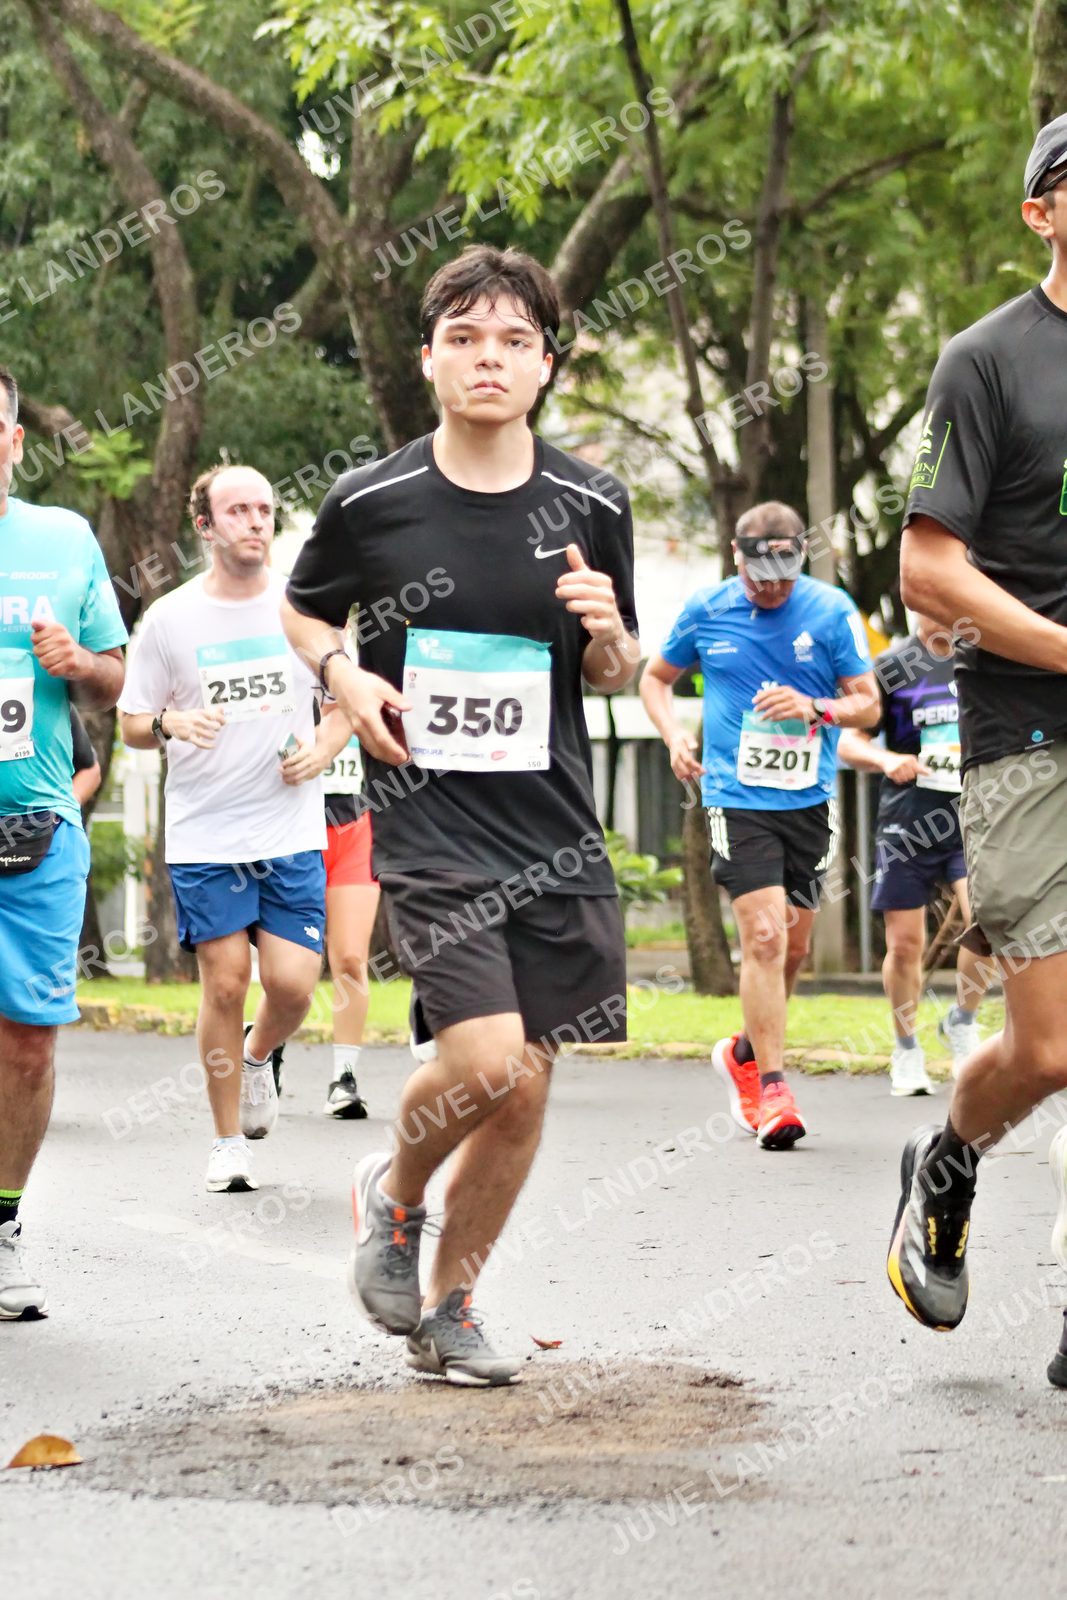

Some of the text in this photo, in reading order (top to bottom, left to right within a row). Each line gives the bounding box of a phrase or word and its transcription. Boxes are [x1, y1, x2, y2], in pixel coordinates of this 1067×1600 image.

[0, 595, 57, 625] RA
[207, 671, 287, 704] 2553
[426, 695, 523, 738] 350
[745, 747, 811, 772] 3201
[925, 755, 961, 773] 44
